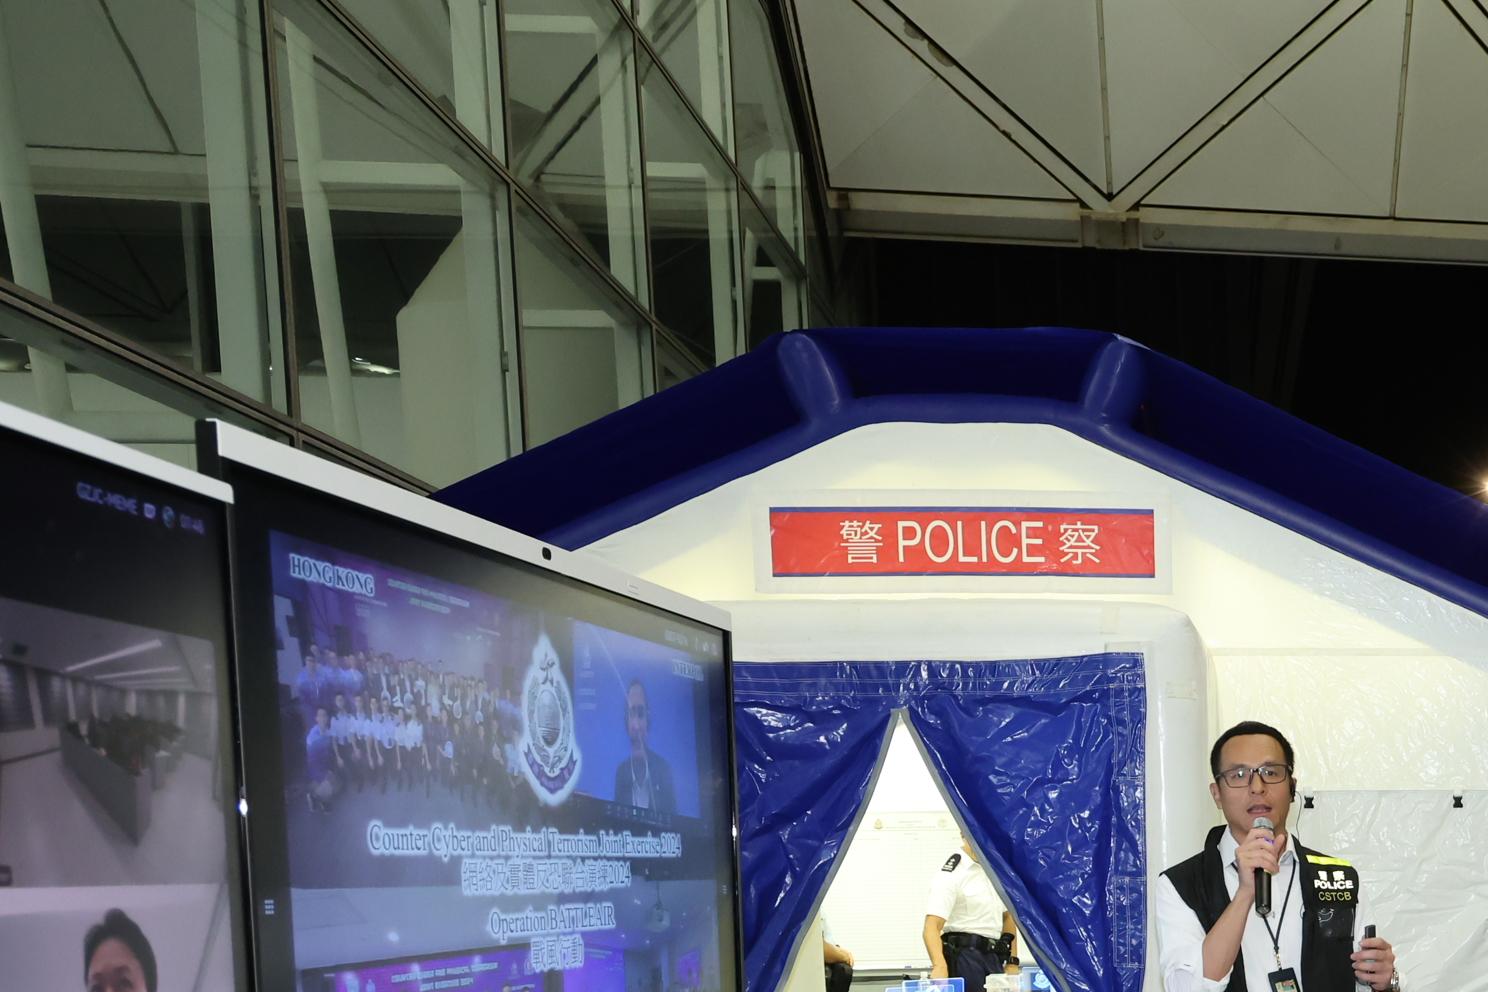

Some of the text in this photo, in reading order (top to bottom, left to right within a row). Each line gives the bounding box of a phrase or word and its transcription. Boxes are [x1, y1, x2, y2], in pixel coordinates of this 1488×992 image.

[897, 519, 1046, 563] POLICE
[291, 555, 333, 586] HONG
[335, 566, 374, 596] KONG
[369, 823, 682, 858] Counter Cyber and Physical Terrorism Joint Exercise 2024
[1314, 879, 1354, 890] POLICE
[1318, 891, 1352, 902] CSTCB
[490, 905, 616, 941] Operation BATTLEAIR
